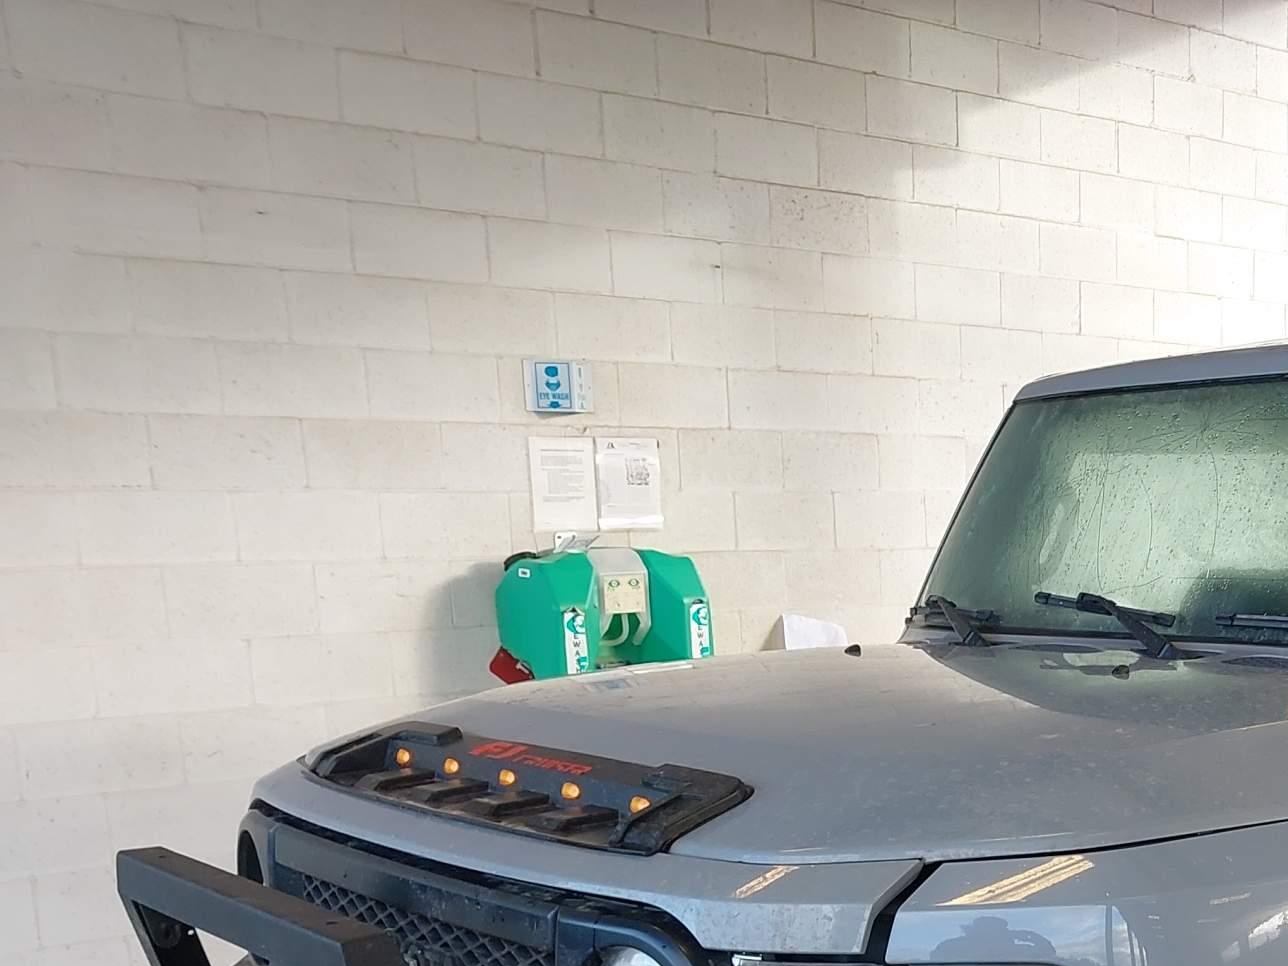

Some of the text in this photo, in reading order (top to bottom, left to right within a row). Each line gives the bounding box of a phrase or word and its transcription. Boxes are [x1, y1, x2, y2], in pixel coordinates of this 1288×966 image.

[540, 392, 570, 401] EYE WASH
[468, 741, 527, 759] FJ
